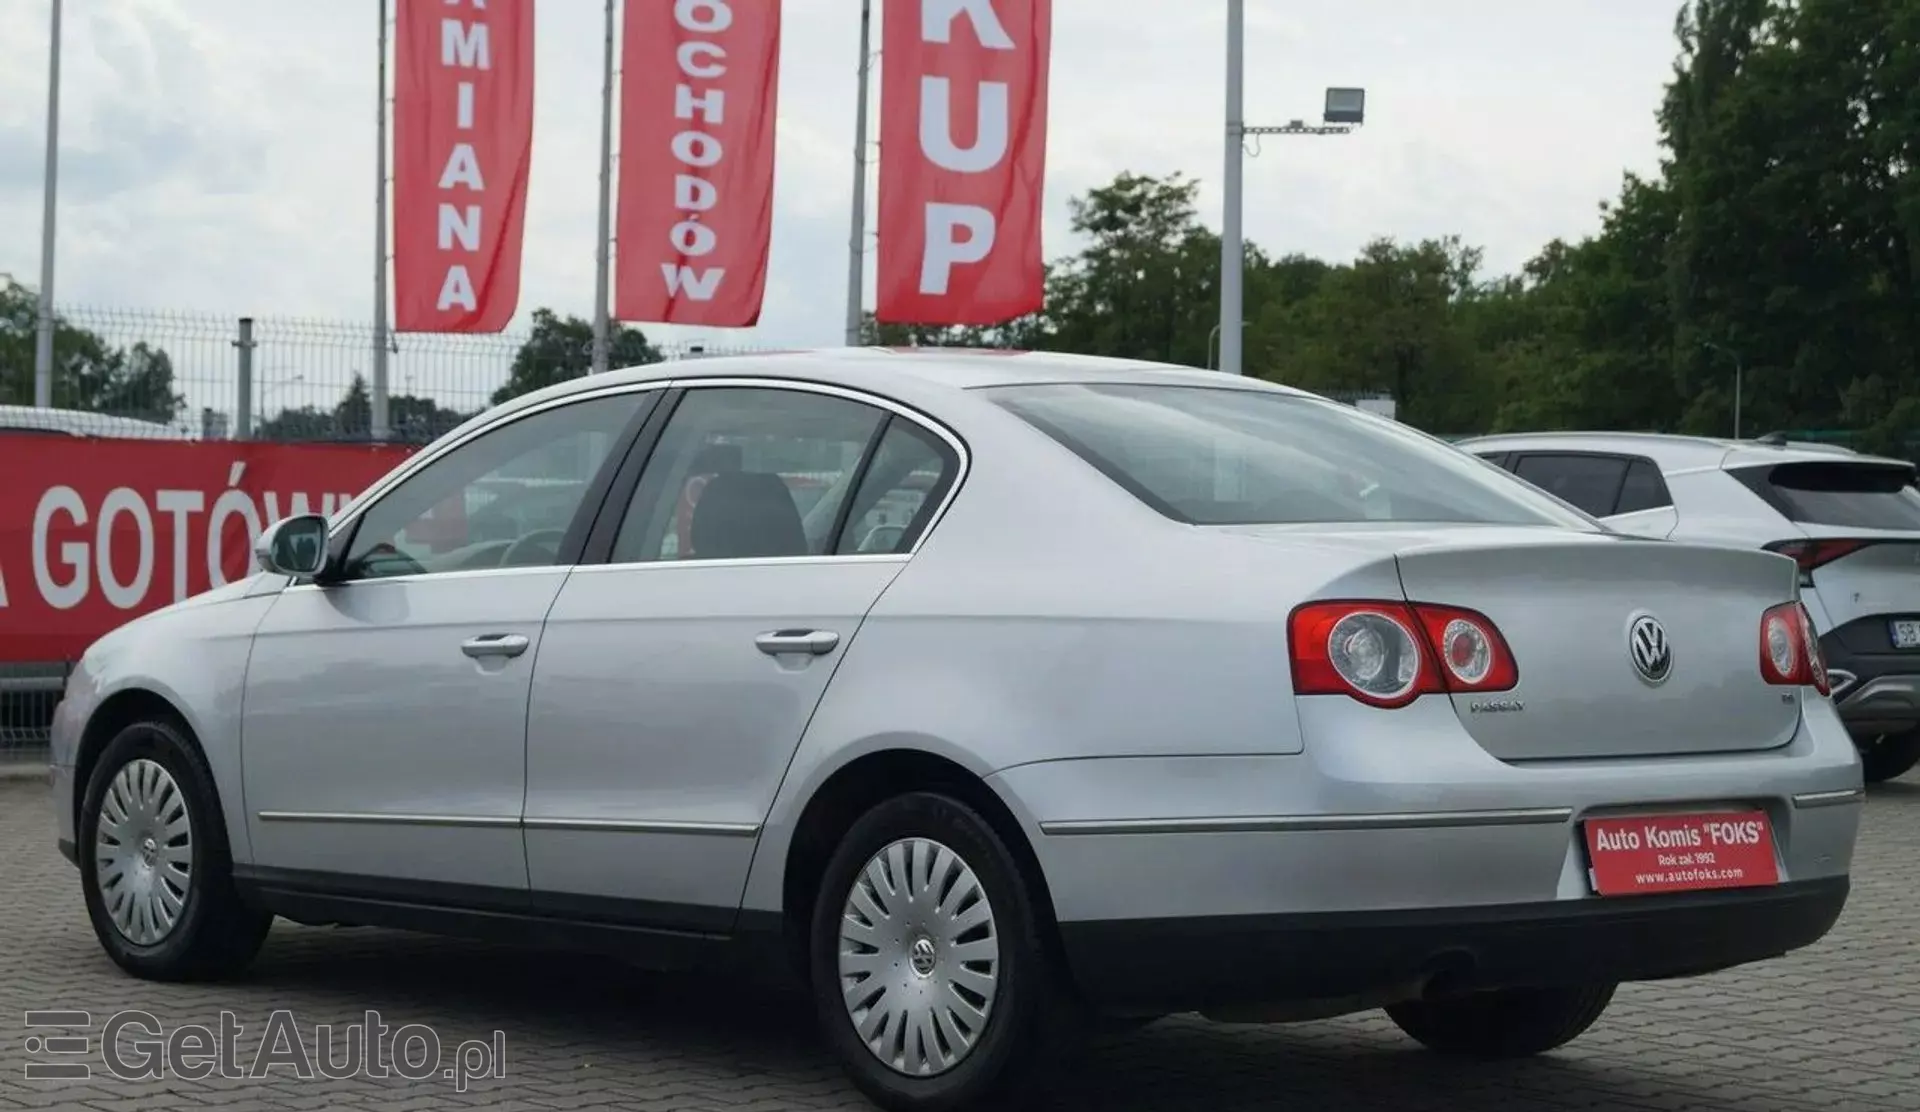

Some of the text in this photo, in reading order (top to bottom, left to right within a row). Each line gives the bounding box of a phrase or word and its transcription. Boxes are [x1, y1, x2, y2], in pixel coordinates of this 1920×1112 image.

[437, 0, 490, 312] MIANA
[1597, 821, 1764, 851] Auto Komis "FOKS"
[1658, 854, 1678, 866] Rok
[1696, 851, 1716, 864] 1992
[1635, 867, 1744, 884] www.autofoks.com
